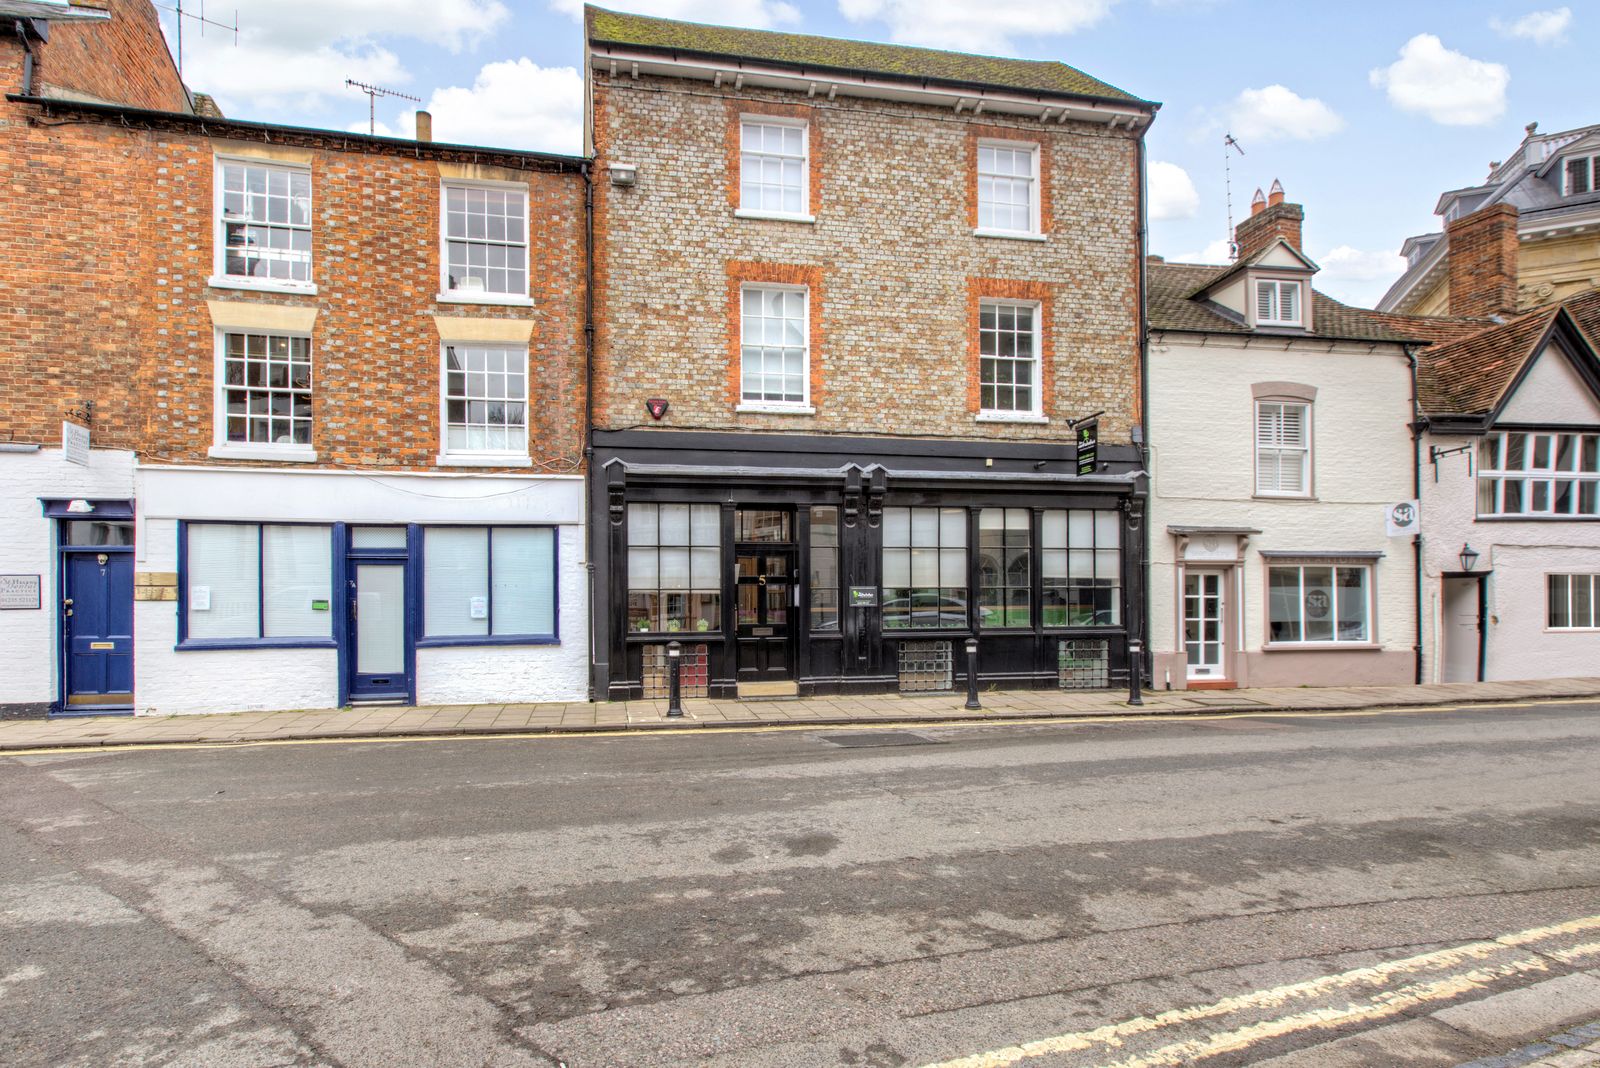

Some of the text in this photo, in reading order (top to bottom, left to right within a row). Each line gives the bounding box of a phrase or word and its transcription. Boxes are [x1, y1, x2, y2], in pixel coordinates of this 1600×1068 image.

[1392, 507, 1415, 522] sa
[759, 575, 766, 586] 5
[1308, 594, 1328, 608] sa
